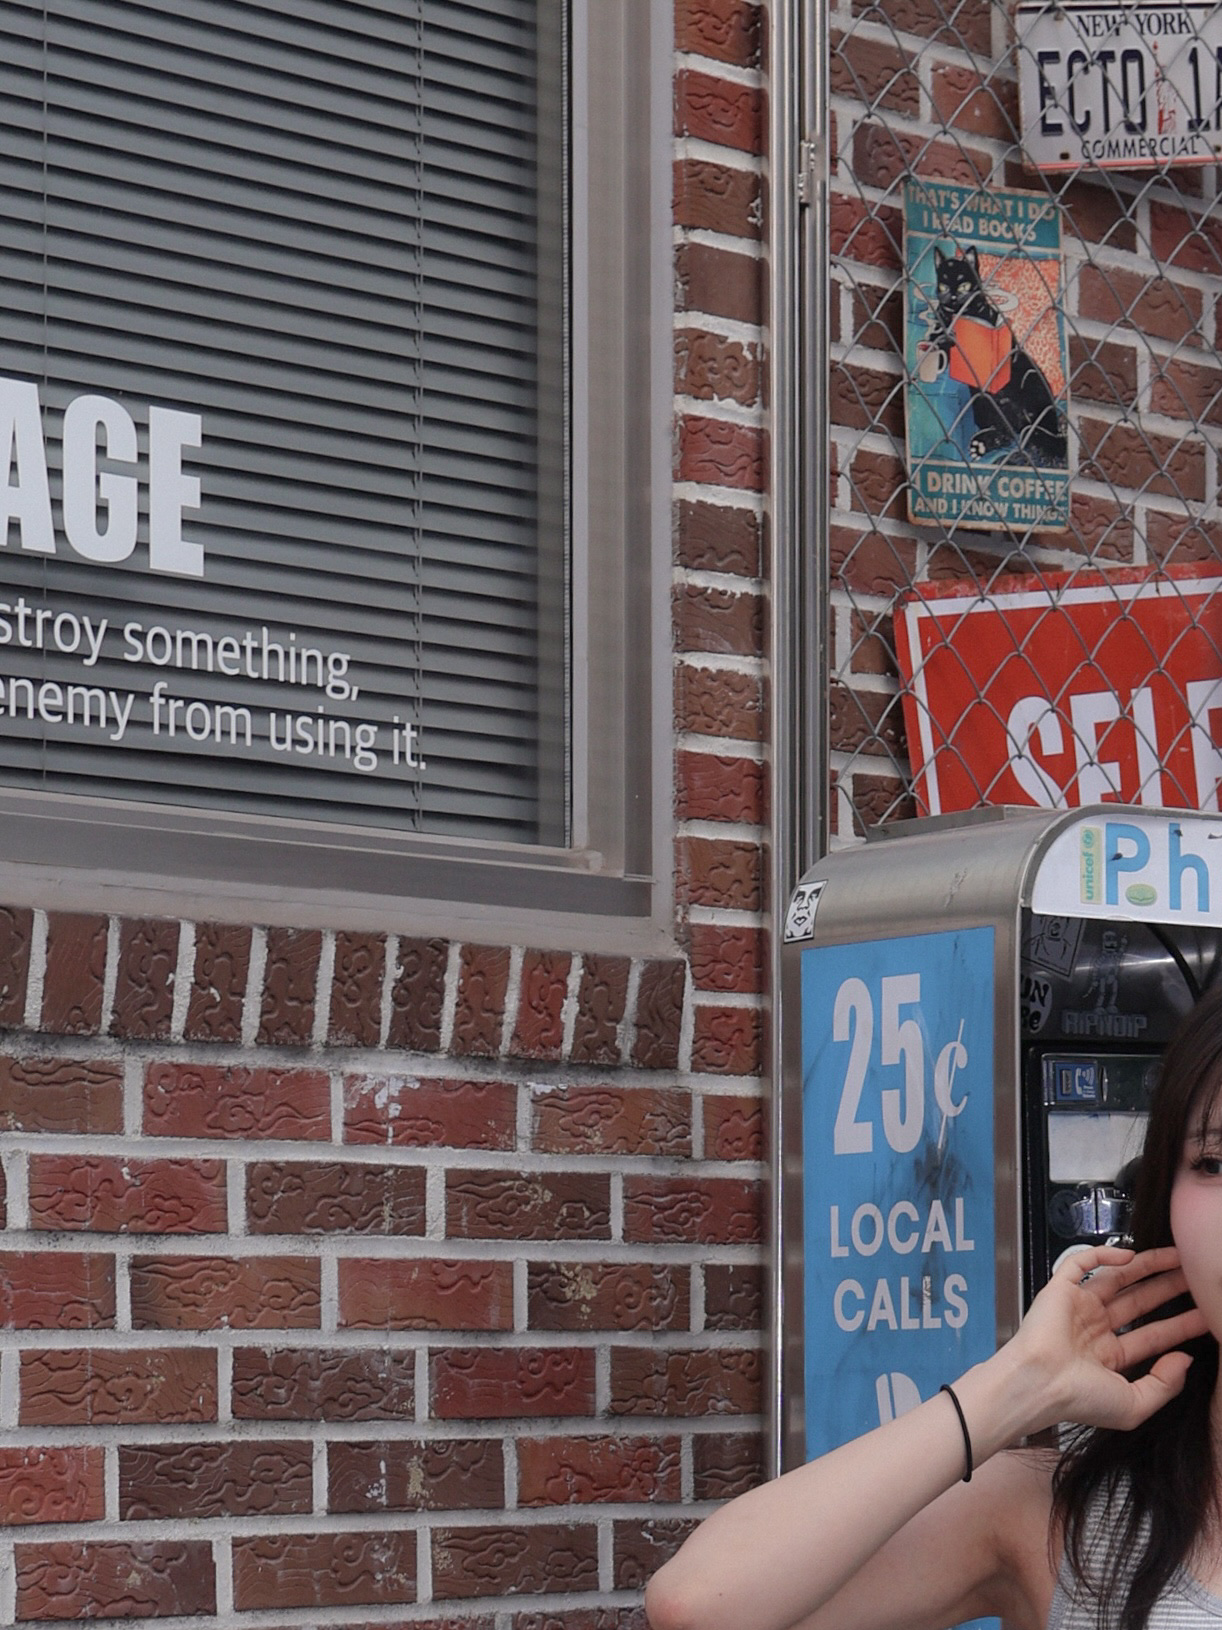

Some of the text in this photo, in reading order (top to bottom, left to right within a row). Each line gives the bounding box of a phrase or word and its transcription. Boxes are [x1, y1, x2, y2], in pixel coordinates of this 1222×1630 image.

[1076, 12, 1193, 38] NEW YORK
[1037, 48, 1147, 137] ECTO
[1081, 136, 1198, 159] COMMERCIAL
[908, 185, 1056, 221] THAT'S WHAT I DO
[923, 210, 1037, 242] I READ BOOKS
[927, 471, 992, 497] DRINK
[997, 476, 1068, 502] COFFEE
[914, 497, 1066, 522] AND I KNOW THINGS
[123, 620, 360, 702] something,
[0, 677, 427, 773] nemy from using it.
[1082, 851, 1095, 901] unicef
[830, 1197, 975, 1258] LOCAL
[833, 1274, 969, 1332] CALLS
